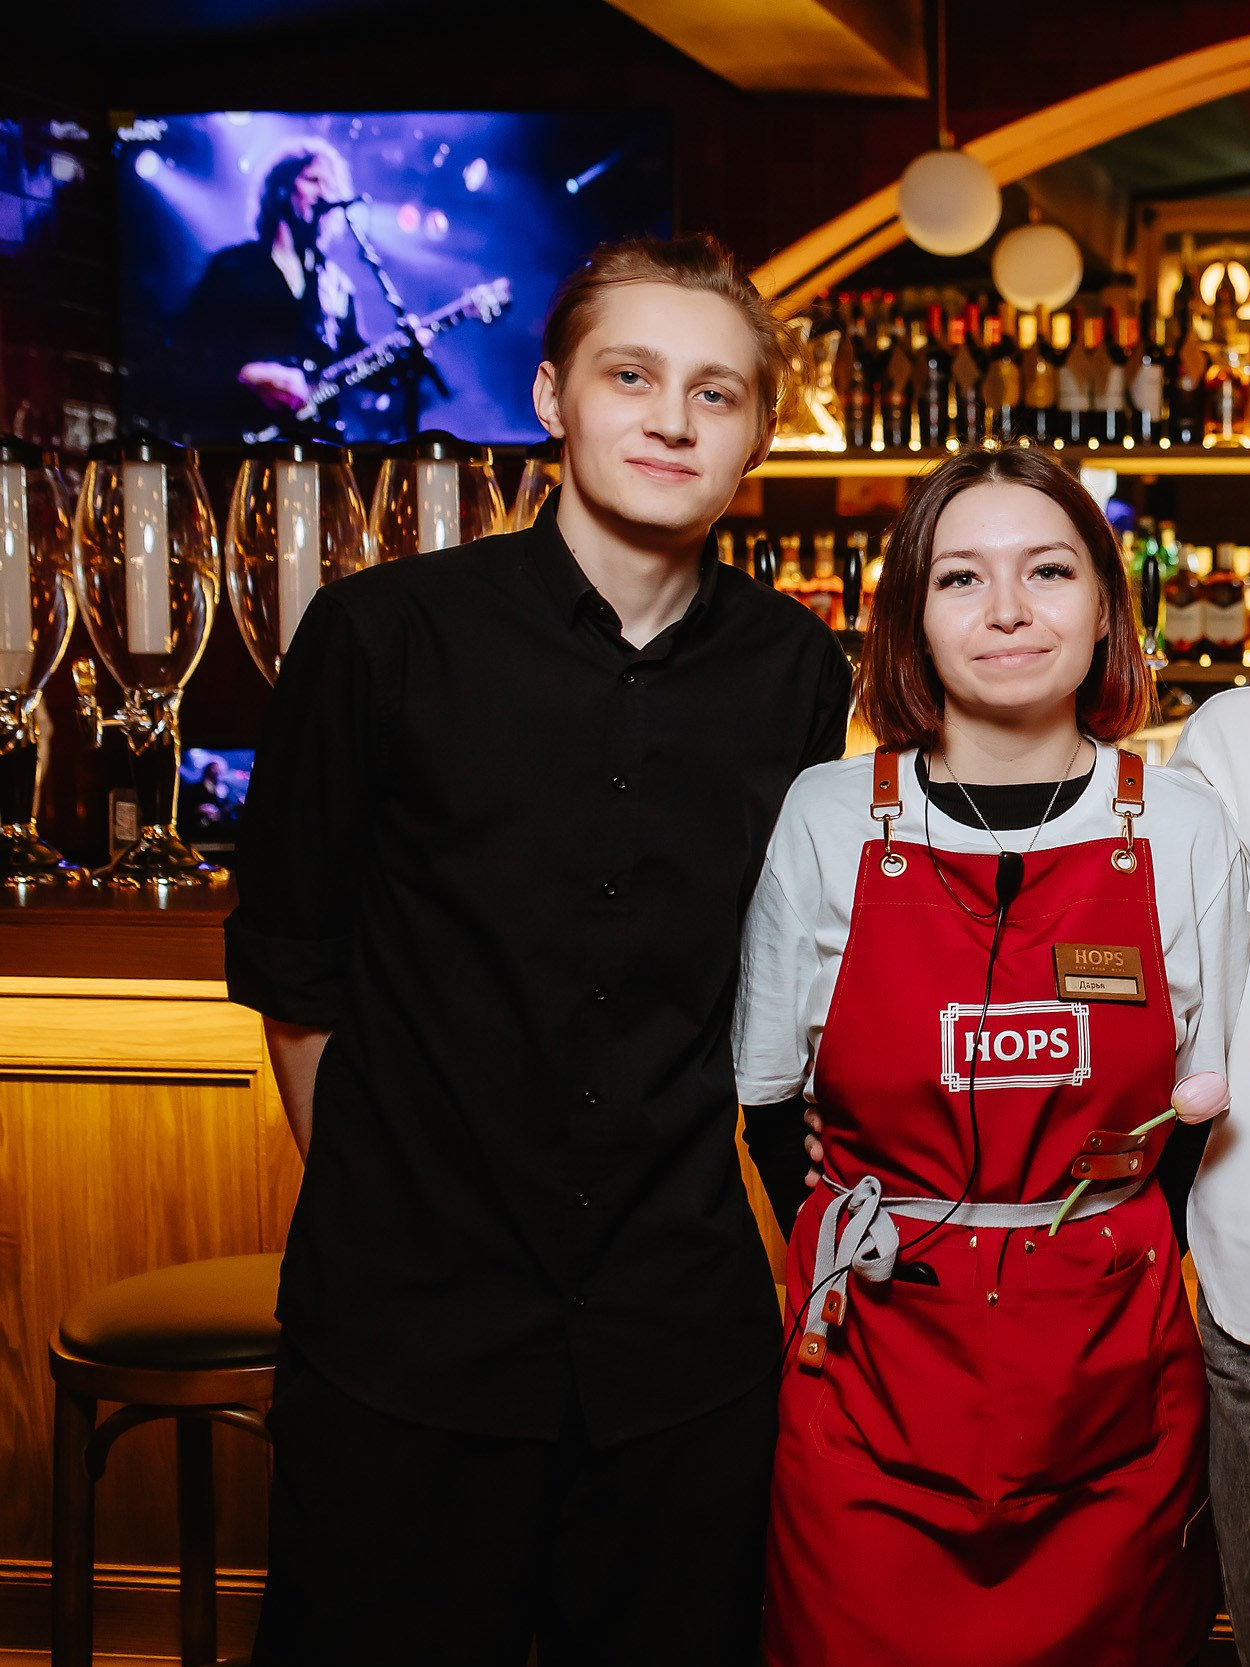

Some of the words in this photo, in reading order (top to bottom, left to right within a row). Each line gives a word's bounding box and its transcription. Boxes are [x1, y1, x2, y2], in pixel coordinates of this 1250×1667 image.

[1074, 949, 1124, 967] HOPS
[1079, 980, 1106, 991] Дарья
[964, 1027, 1070, 1062] HOPS
